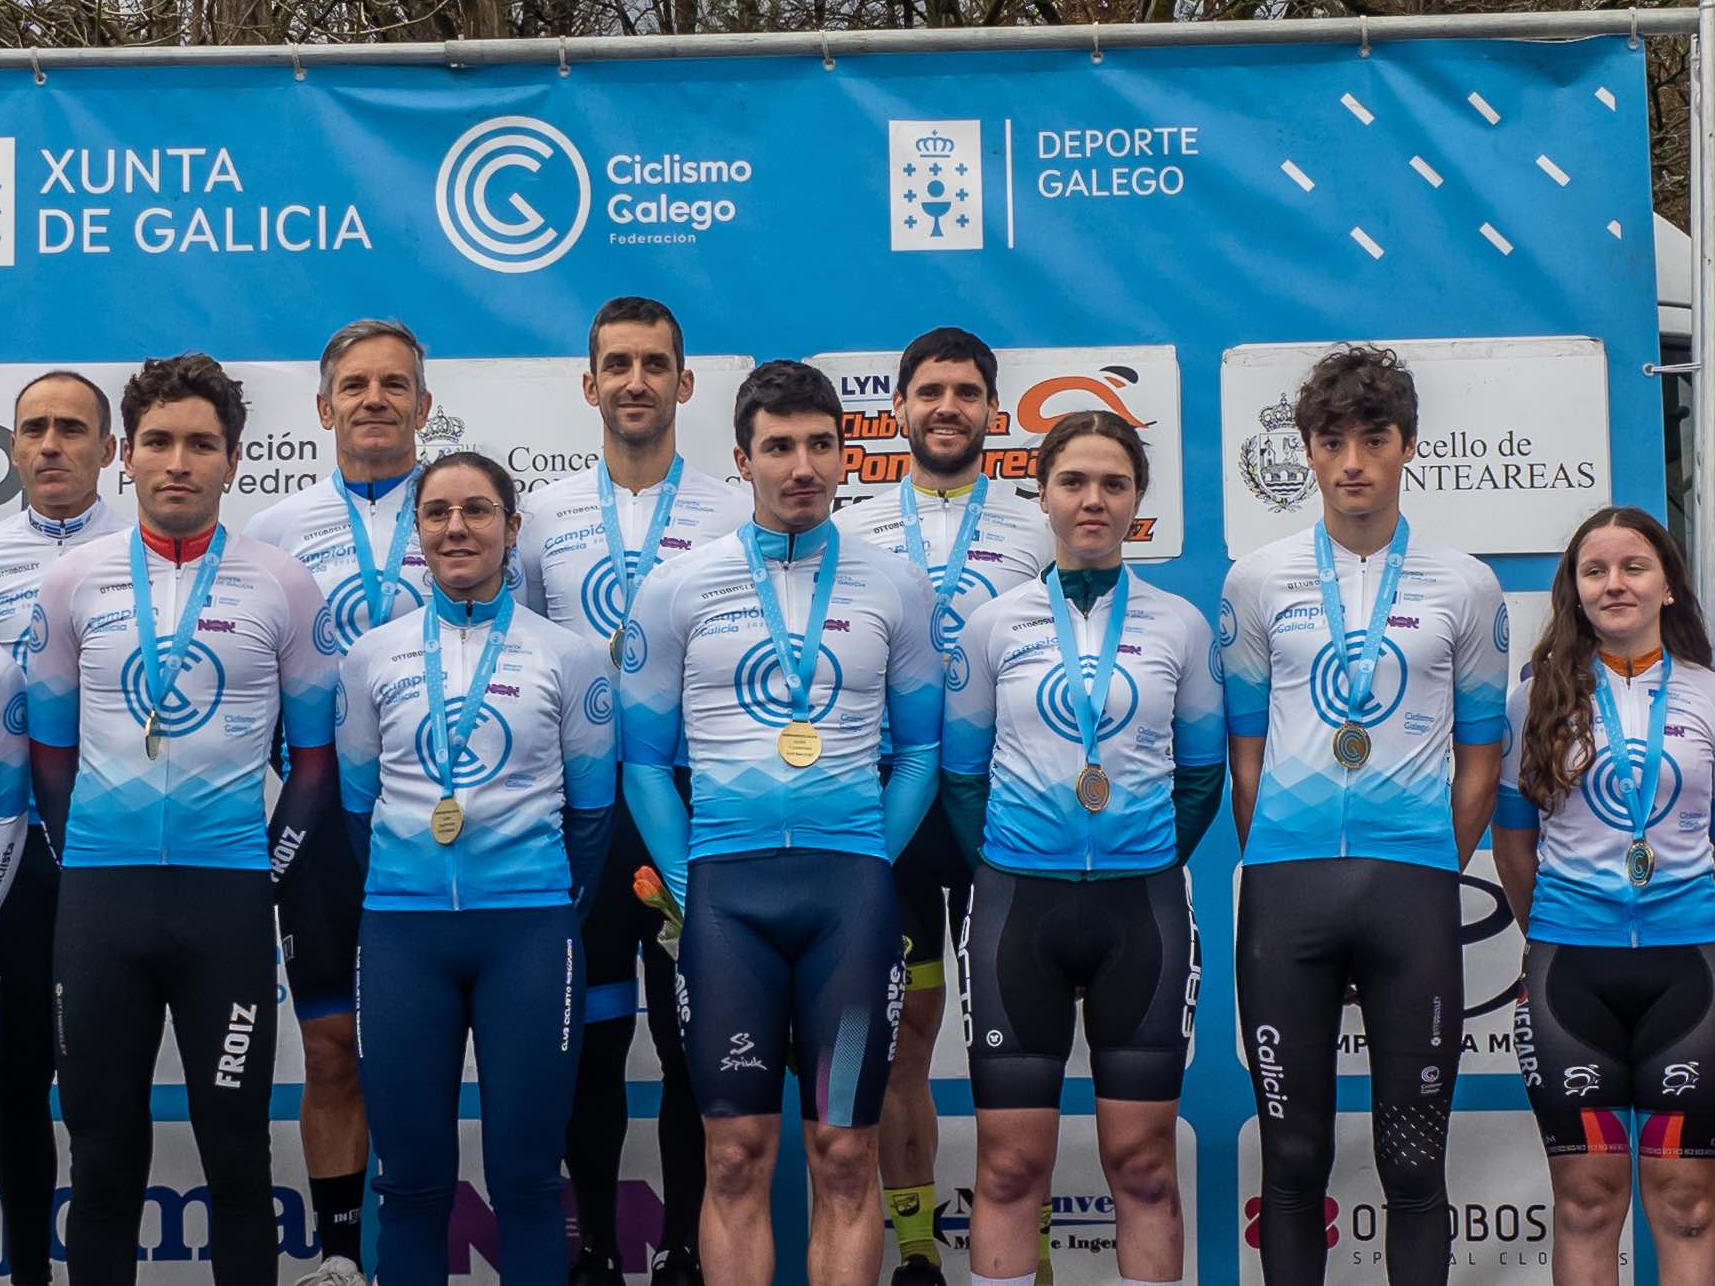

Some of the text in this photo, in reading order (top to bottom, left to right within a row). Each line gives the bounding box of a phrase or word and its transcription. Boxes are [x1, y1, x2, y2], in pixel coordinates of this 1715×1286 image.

[1039, 127, 1198, 159] DEPORTE
[40, 148, 243, 194] XUNTA
[606, 154, 752, 185] Ciclismo
[1038, 166, 1184, 198] GALEGO
[607, 193, 736, 230] Galego
[39, 205, 372, 254] DE GALICIA
[609, 232, 697, 245] Federación
[842, 411, 898, 440] Club
[1416, 430, 1532, 459] cello de
[508, 446, 601, 473] Conce
[118, 468, 318, 495] Pvedra
[1403, 461, 1596, 492] NTEAREAS
[556, 504, 601, 519] OTTOBOSL
[544, 523, 606, 550] Campió
[701, 583, 756, 600] OTTOBOSLE
[1274, 603, 1346, 621] Campin
[215, 1002, 258, 1089] FROIZ
[719, 1055, 768, 1072] Spiuk
[1255, 1024, 1289, 1120] Galicia
